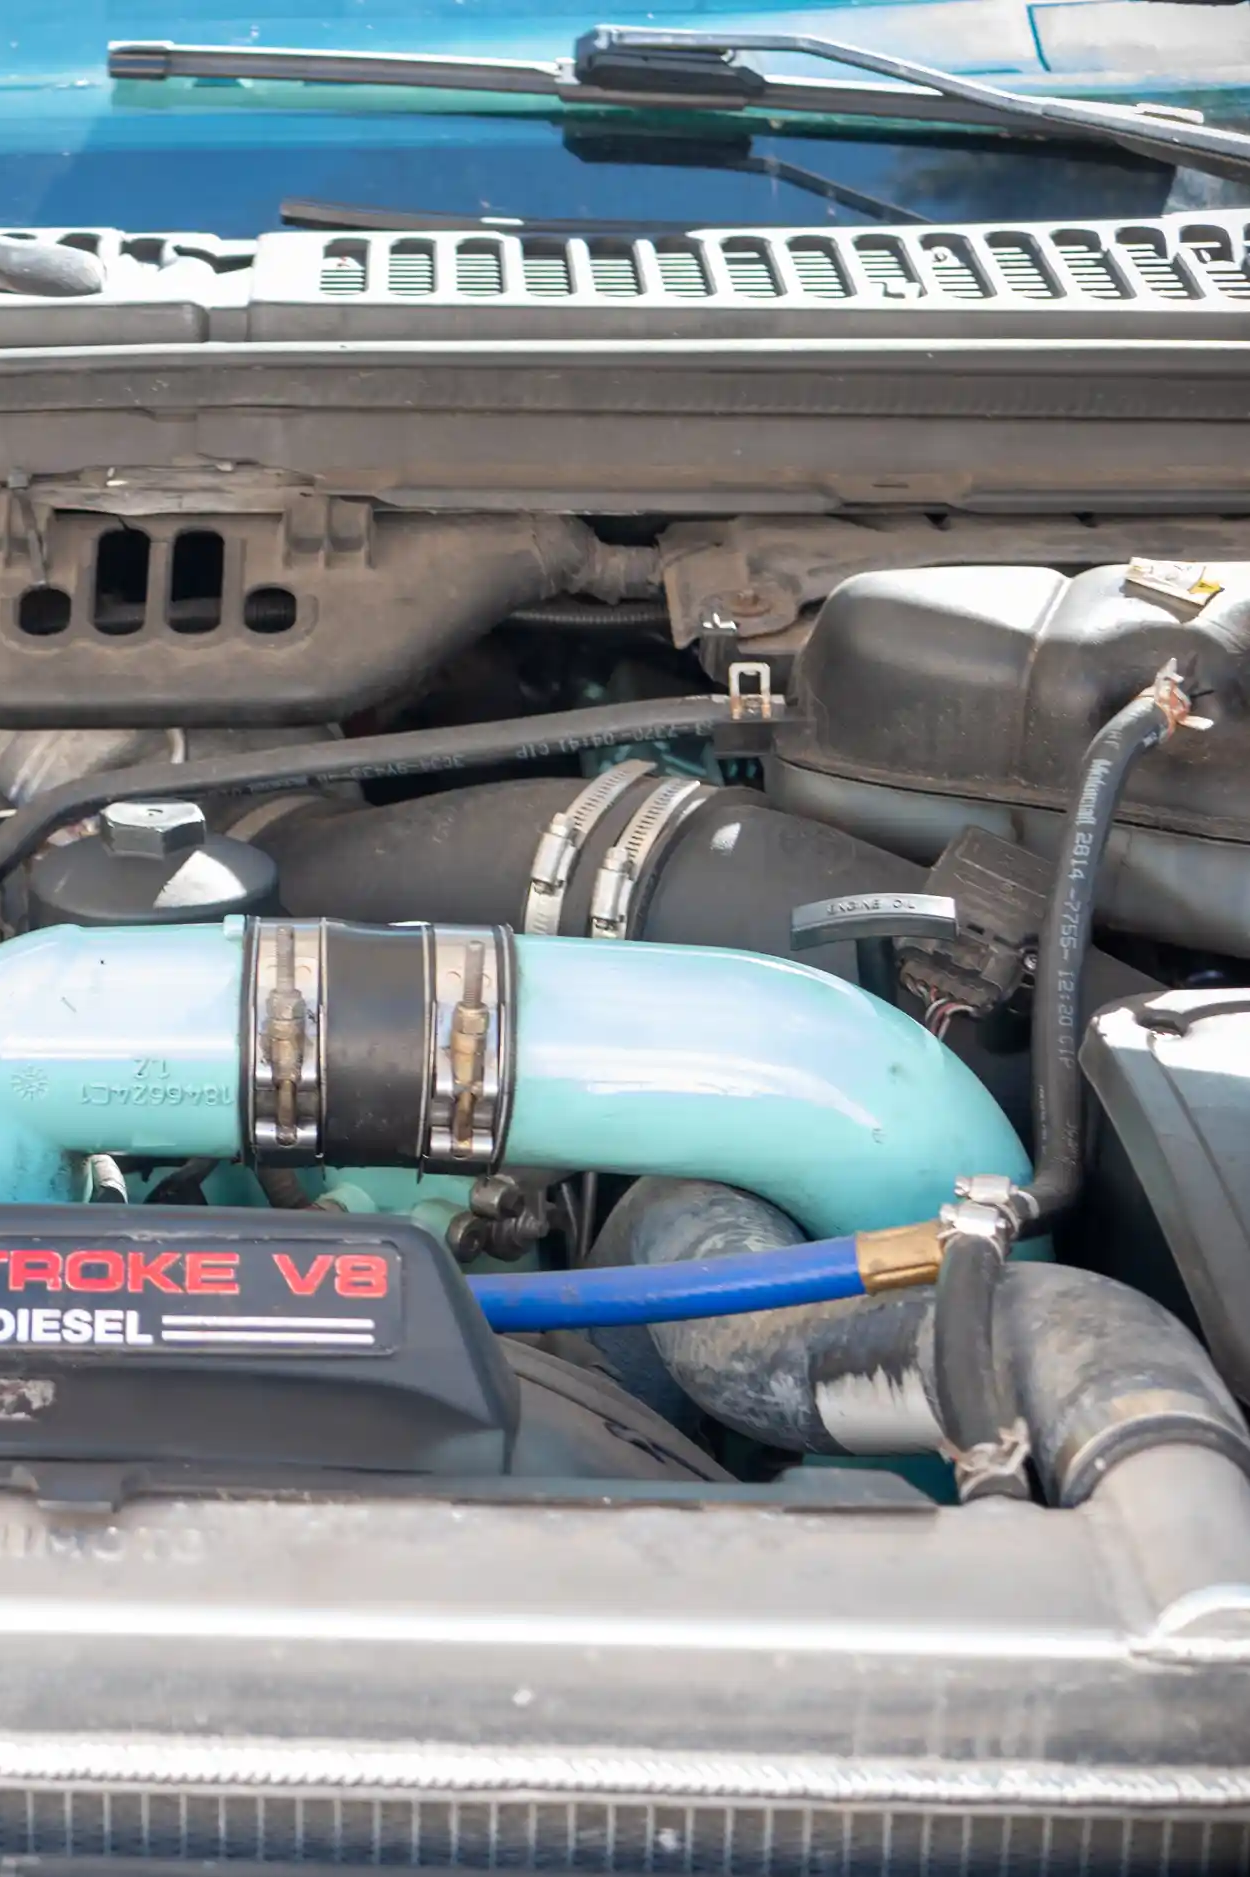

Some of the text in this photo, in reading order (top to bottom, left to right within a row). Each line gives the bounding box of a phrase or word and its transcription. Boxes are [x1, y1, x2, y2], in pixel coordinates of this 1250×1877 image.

[1057, 969, 1075, 1027] 12:20
[81, 1082, 234, 1106] 1846624C1
[271, 1252, 388, 1299] V8
